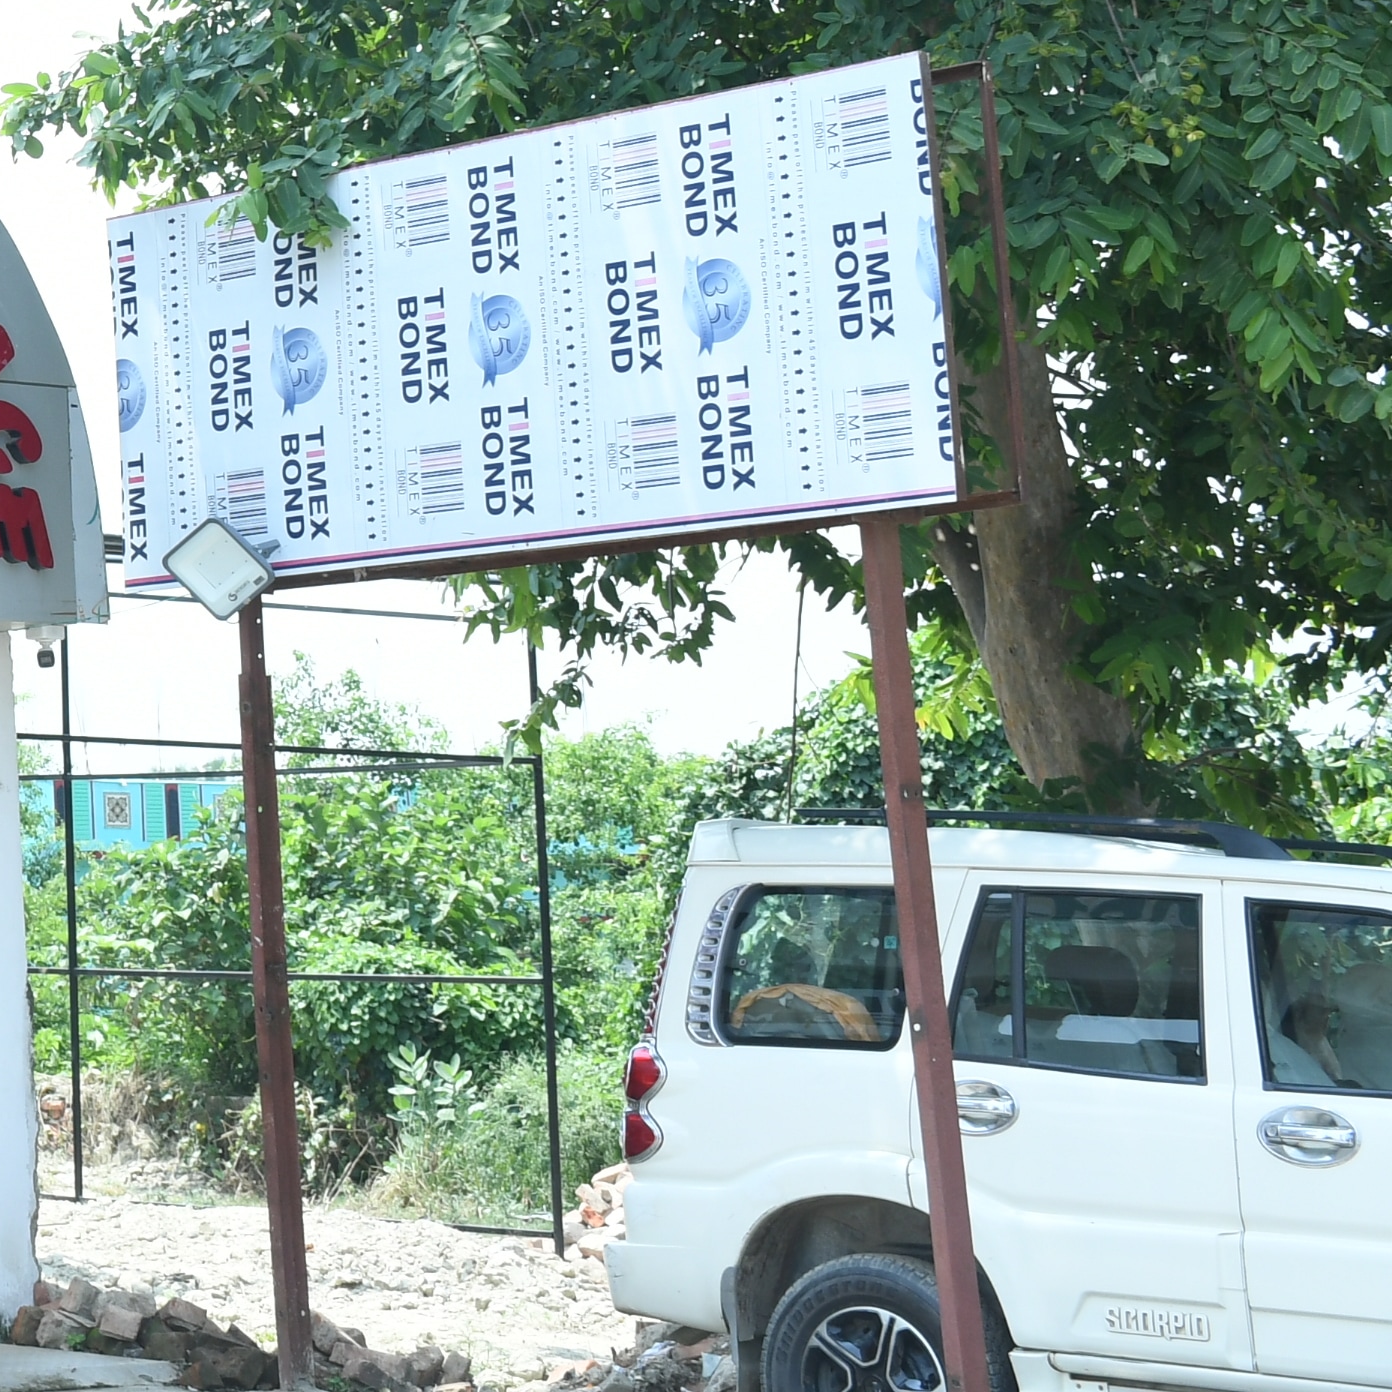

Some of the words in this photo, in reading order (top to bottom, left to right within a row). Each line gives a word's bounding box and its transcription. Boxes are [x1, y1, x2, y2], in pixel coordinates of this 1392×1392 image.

[588, 165, 599, 191] BOND
[679, 123, 708, 238] BOND
[707, 112, 738, 237] TIMEX
[813, 121, 824, 149] BOND
[197, 240, 205, 265] BOND
[205, 233, 217, 284] IMEX
[271, 228, 295, 309] OND
[295, 230, 318, 308] MEX
[383, 204, 393, 230] BOND
[466, 165, 493, 275] BOND
[492, 155, 519, 274] TIMEX
[115, 231, 138, 340] TIMEX
[604, 260, 634, 374] BOND
[632, 250, 662, 373] TIMEX
[702, 276, 730, 325] 35
[832, 221, 863, 340] BOND
[861, 211, 894, 340] TIMEX
[207, 328, 231, 432] BOND
[229, 319, 254, 432] TIMEX
[286, 343, 310, 387] 35
[396, 295, 423, 404] BOND
[422, 286, 449, 404] TIMEX
[486, 311, 512, 357] 35
[479, 405, 507, 516] BOND
[506, 396, 534, 517] TIMEX
[606, 442, 617, 469] BOND
[695, 374, 726, 491] BOND
[724, 365, 756, 491] TIMEX
[834, 412, 846, 440] BOND
[125, 452, 148, 562] TIMEX
[280, 433, 304, 539] BOND
[304, 425, 329, 540] TIMEX
[396, 469, 406, 495] BOND
[1106, 1307, 1210, 1341] SCORPIO
